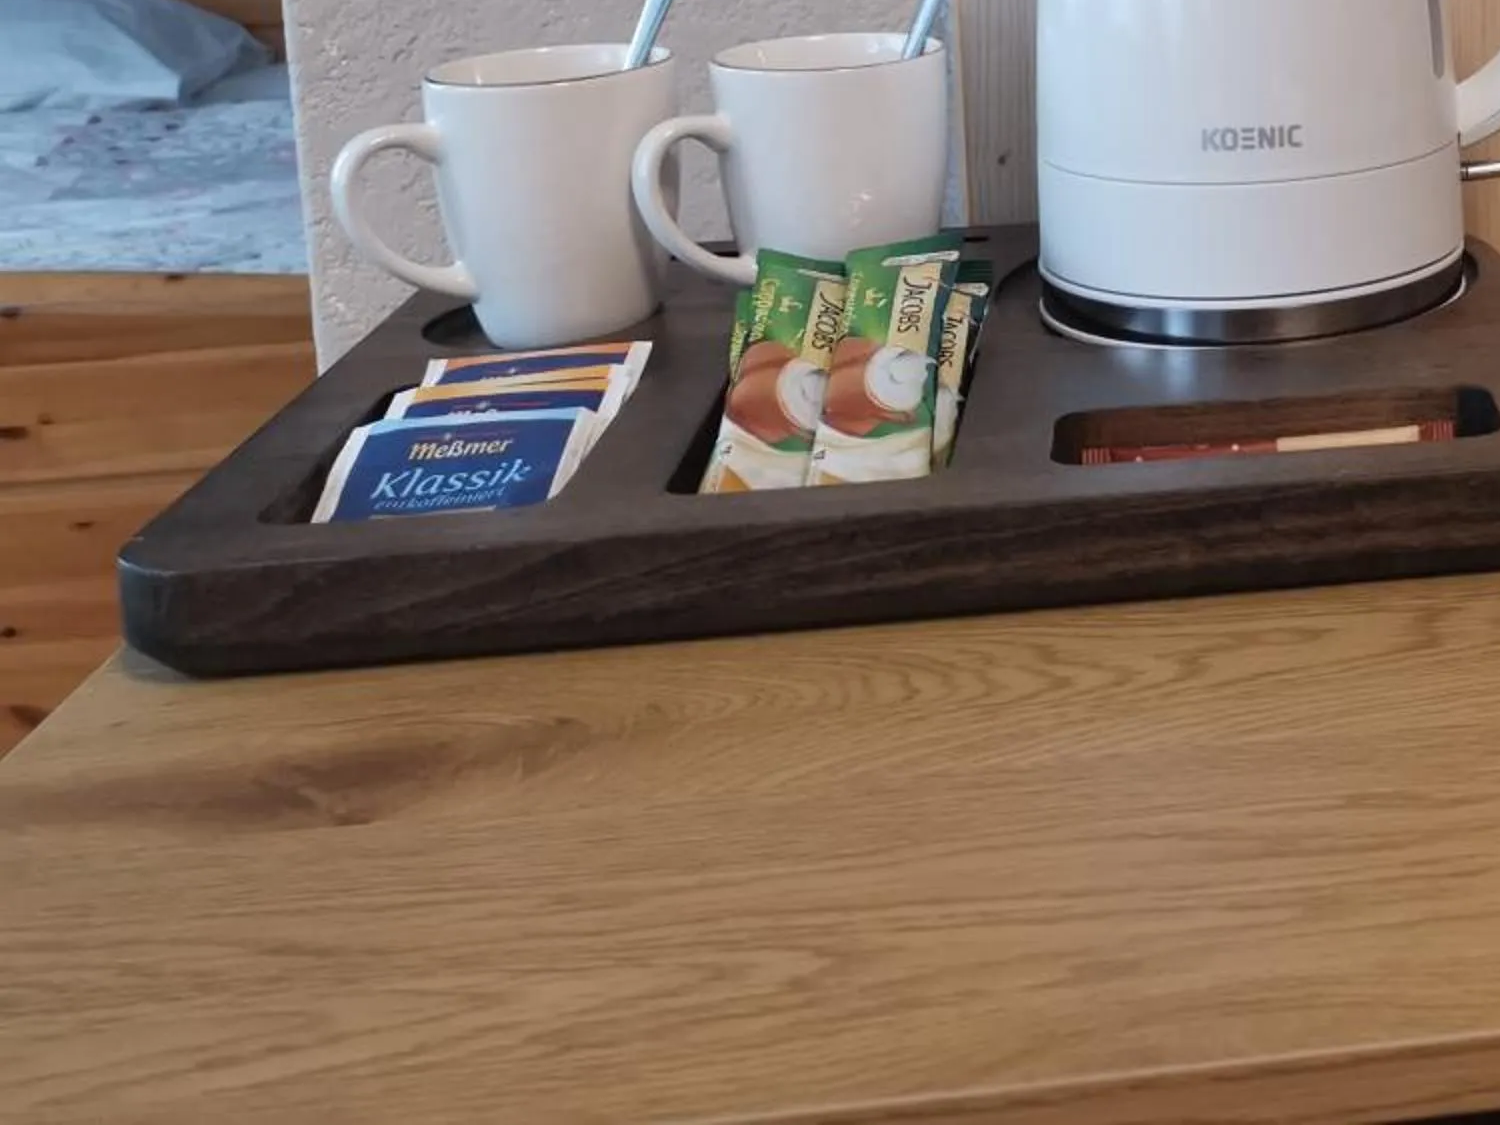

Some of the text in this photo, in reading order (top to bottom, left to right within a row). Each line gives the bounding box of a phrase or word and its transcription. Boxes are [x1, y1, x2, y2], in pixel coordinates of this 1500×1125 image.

[1201, 124, 1304, 152] KOENIC
[811, 290, 844, 354] JACOBS
[898, 276, 933, 334] JACOBS
[369, 458, 532, 500] Klassik
